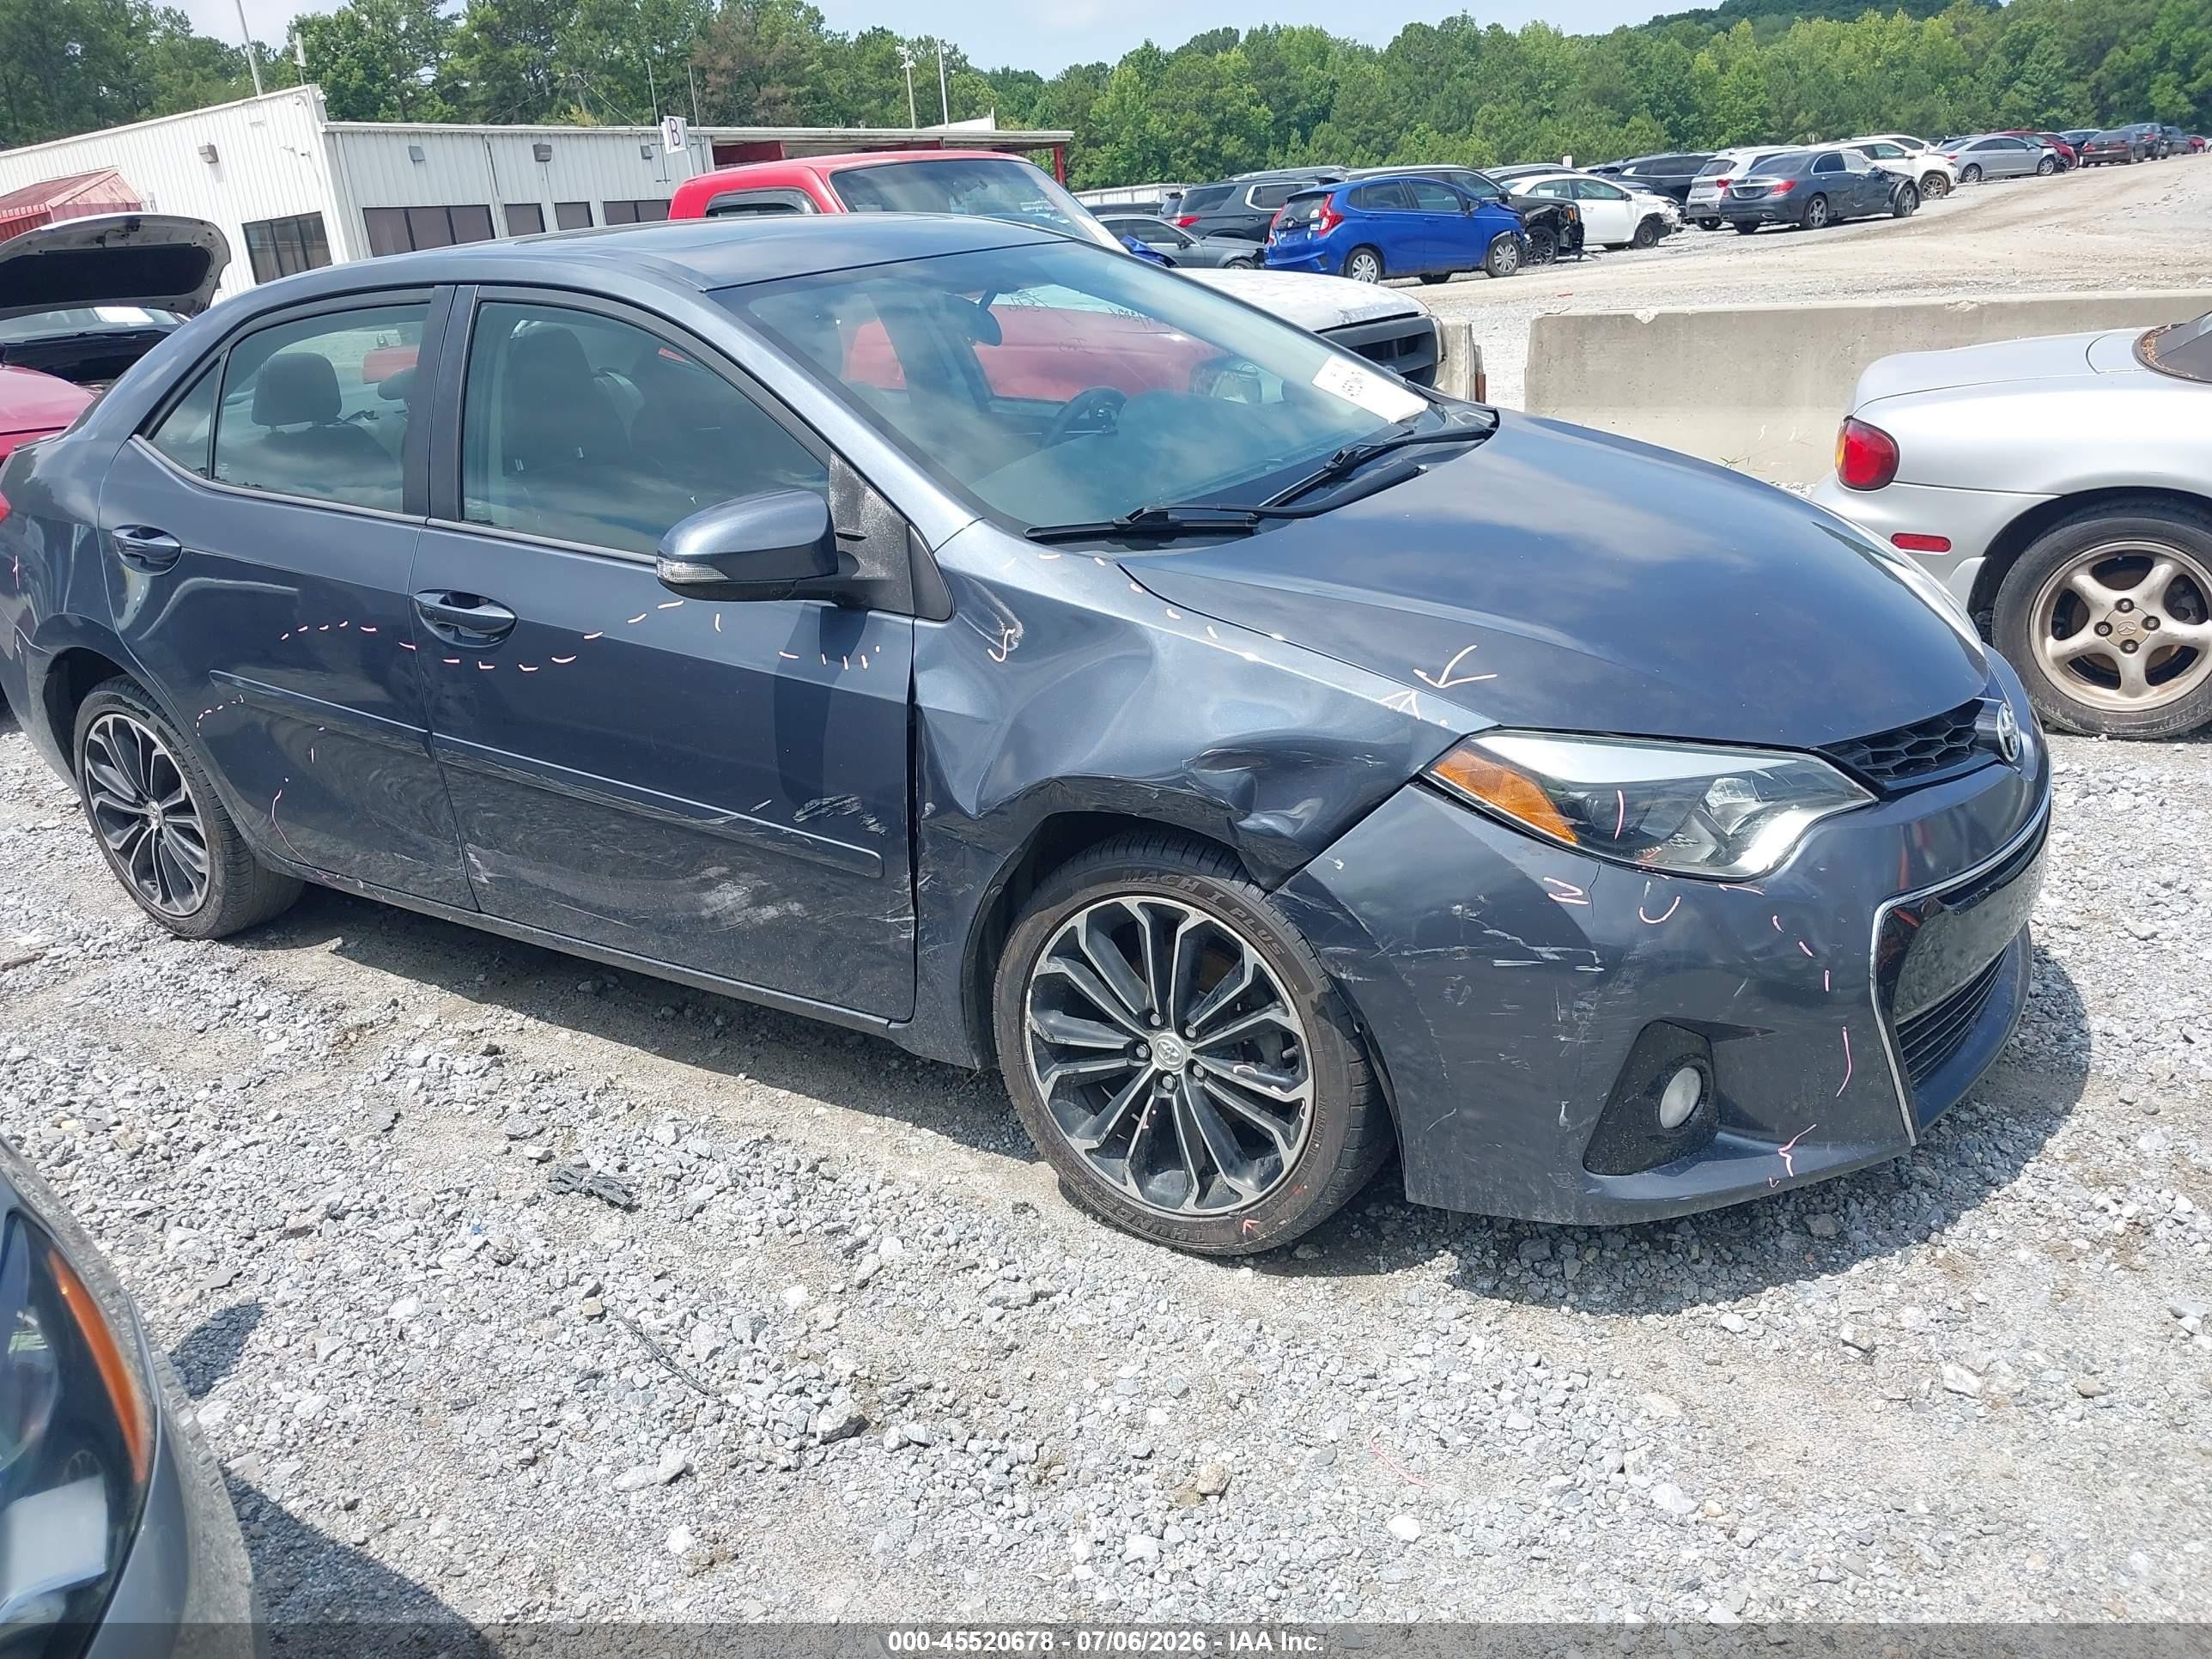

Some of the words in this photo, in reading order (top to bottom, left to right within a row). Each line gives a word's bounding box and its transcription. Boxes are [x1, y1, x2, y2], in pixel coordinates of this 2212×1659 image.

[669, 118, 681, 146] B
[1119, 869, 1201, 893] MACH
[1229, 908, 1285, 956] PLUS
